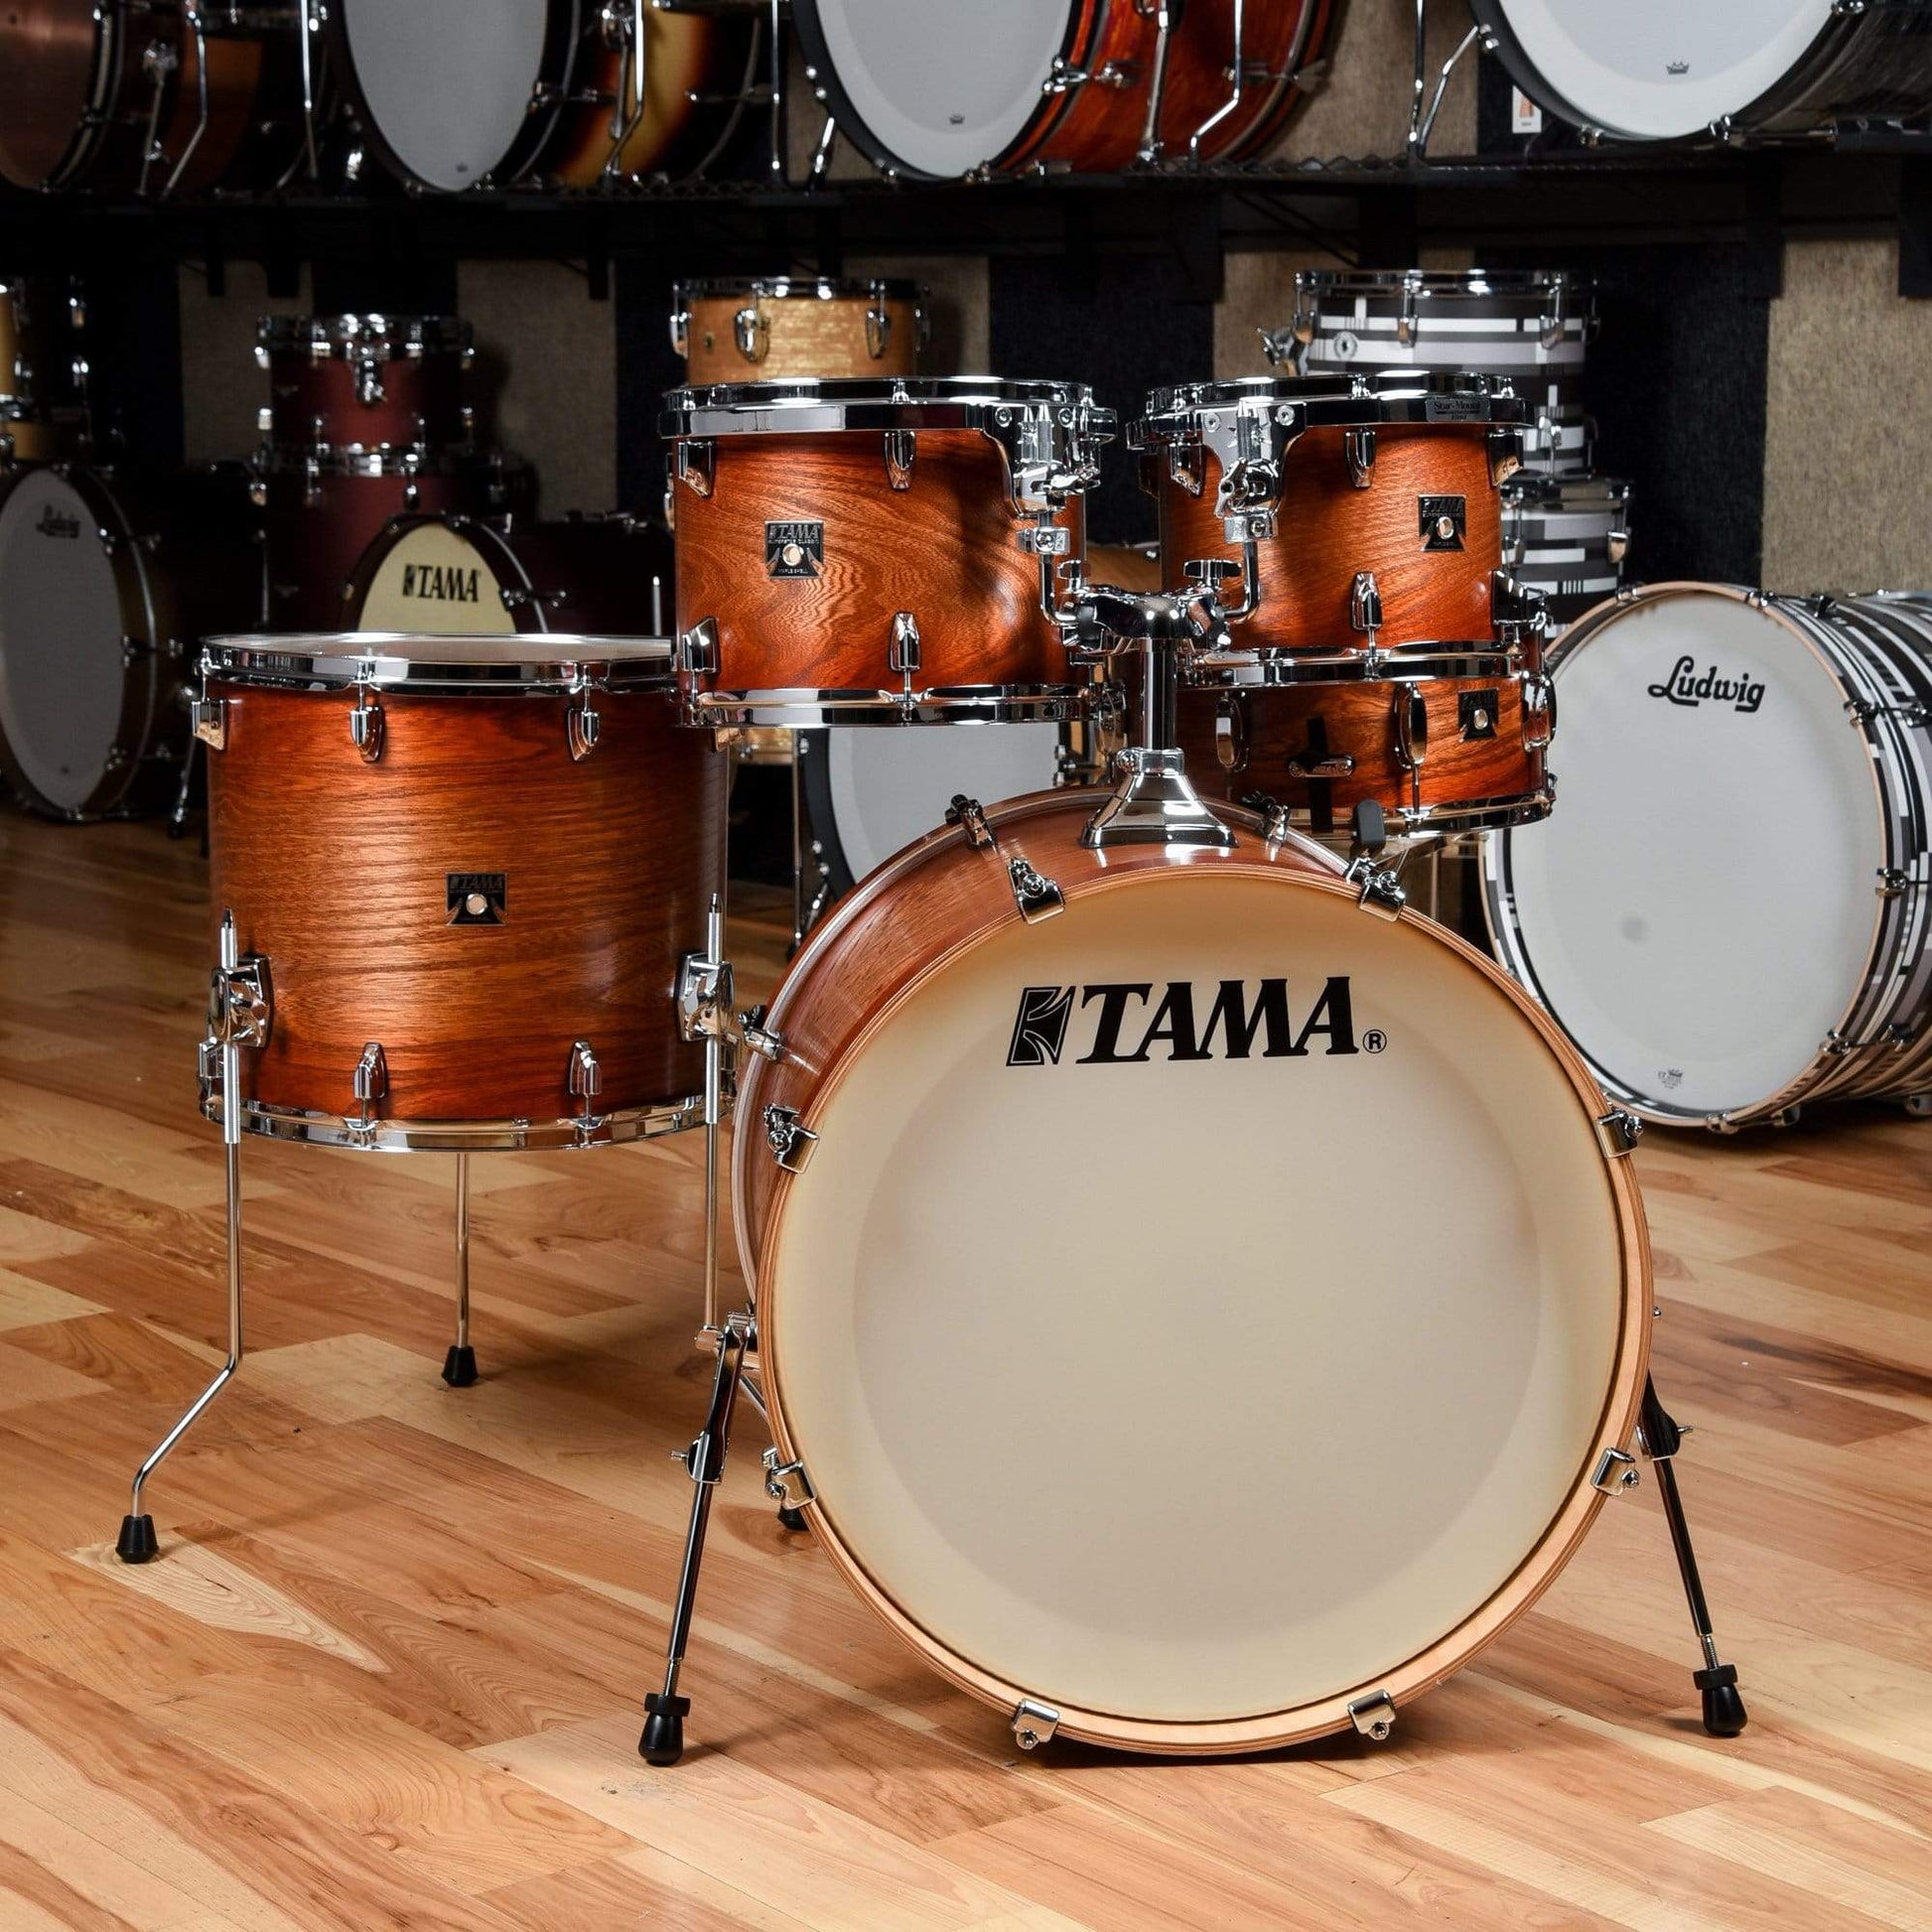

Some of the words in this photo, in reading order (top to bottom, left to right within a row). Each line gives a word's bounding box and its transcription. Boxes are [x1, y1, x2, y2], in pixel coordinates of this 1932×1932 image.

[776, 524, 820, 539] TAMA
[417, 564, 479, 603] TAMA
[1647, 654, 1765, 713] Ludwig
